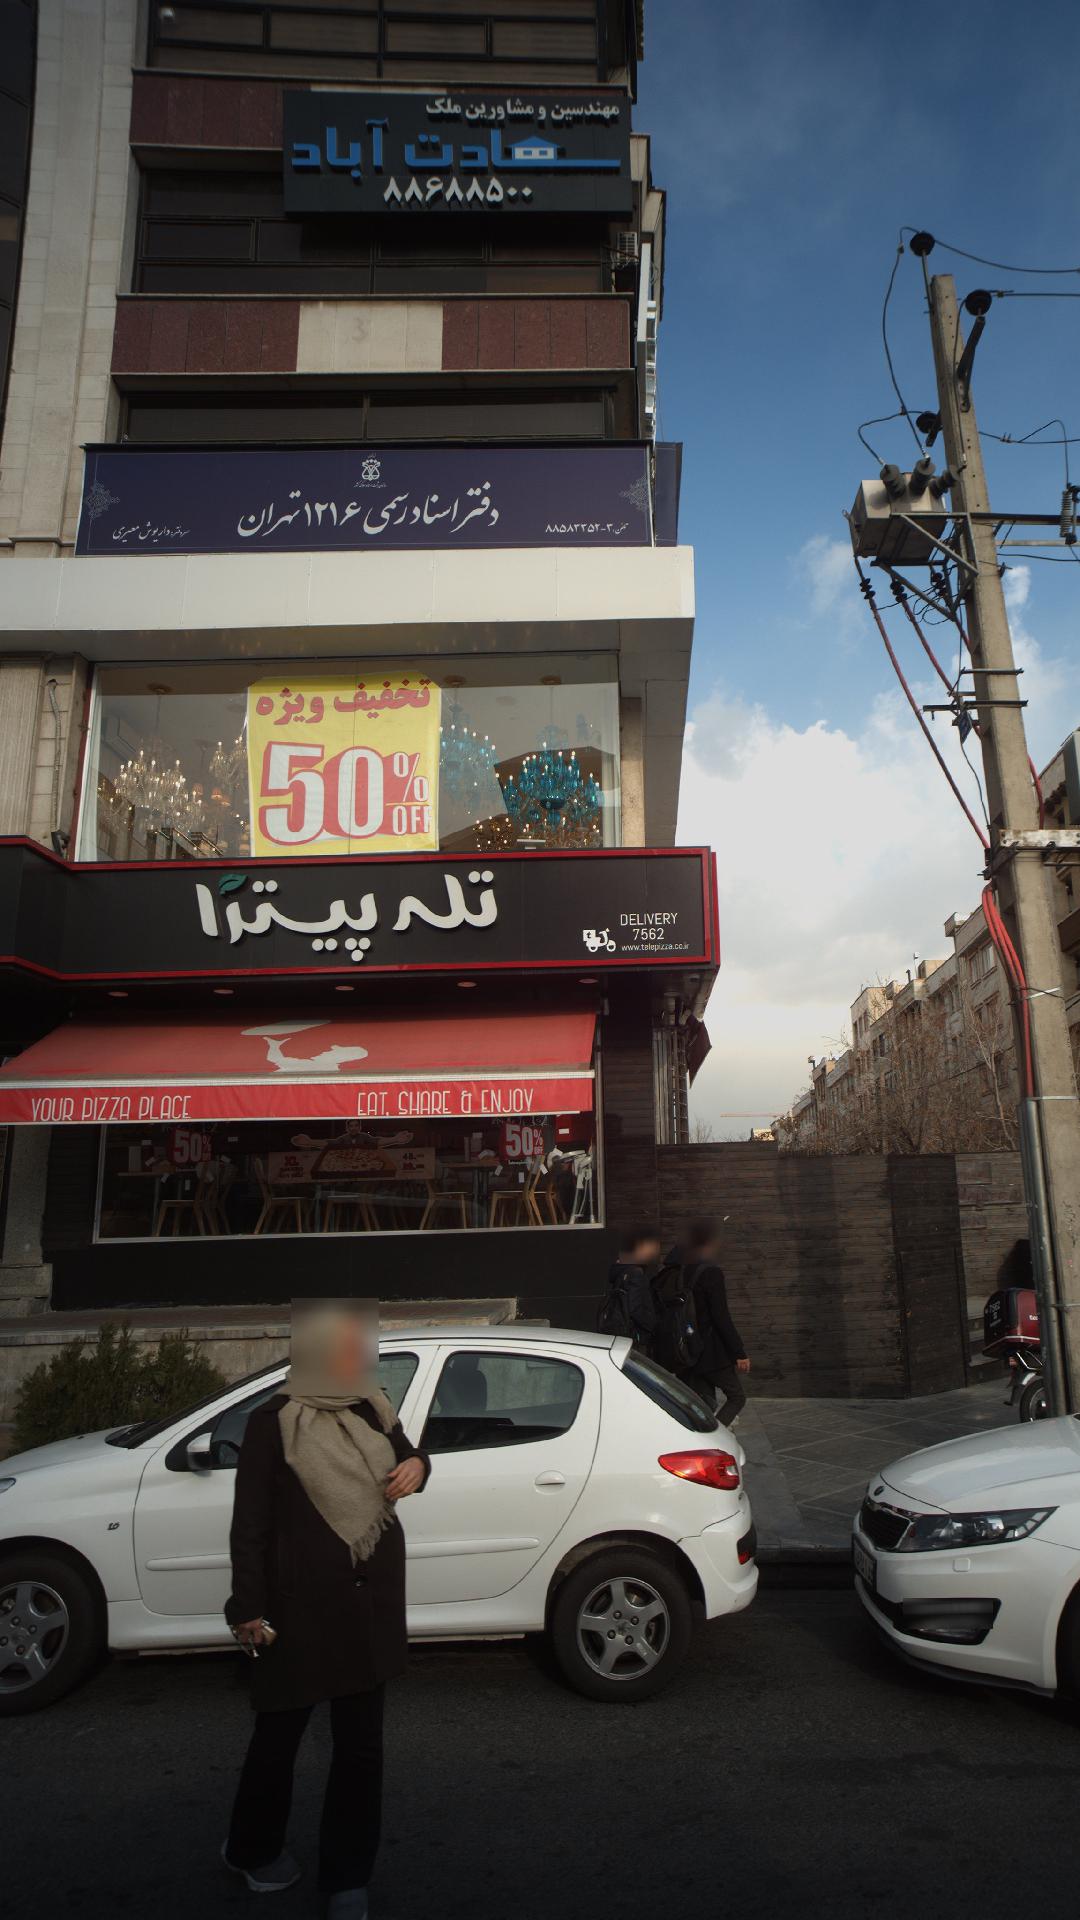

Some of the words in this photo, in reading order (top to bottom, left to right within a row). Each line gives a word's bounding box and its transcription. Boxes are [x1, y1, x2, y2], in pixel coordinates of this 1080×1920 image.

[425, 98, 462, 115] ملک
[465, 99, 534, 120] مشاورین
[538, 106, 547, 120] و
[551, 102, 620, 120] مهندسین
[292, 118, 389, 180] آباد
[383, 176, 534, 203] ۸۸۶۸۸۵۰۰
[237, 490, 301, 537] تهران
[304, 501, 361, 527] ۱۲۱۶
[363, 491, 409, 535] رسمی
[410, 494, 459, 525] اسناد
[449, 481, 500, 533] دفتر
[256, 687, 325, 726] ویژه
[333, 678, 432, 720] تخفیف
[258, 740, 430, 846] 50%
[392, 870, 498, 932] تله
[620, 912, 678, 926] DELIVERY
[632, 927, 665, 941] 7562
[31, 1097, 75, 1122] YOUR
[81, 1096, 131, 1121] PIZZA
[138, 1095, 192, 1120] PLACE
[398, 1090, 452, 1115] SHARE
[461, 1090, 473, 1114] &
[481, 1088, 534, 1113] ENJOY
